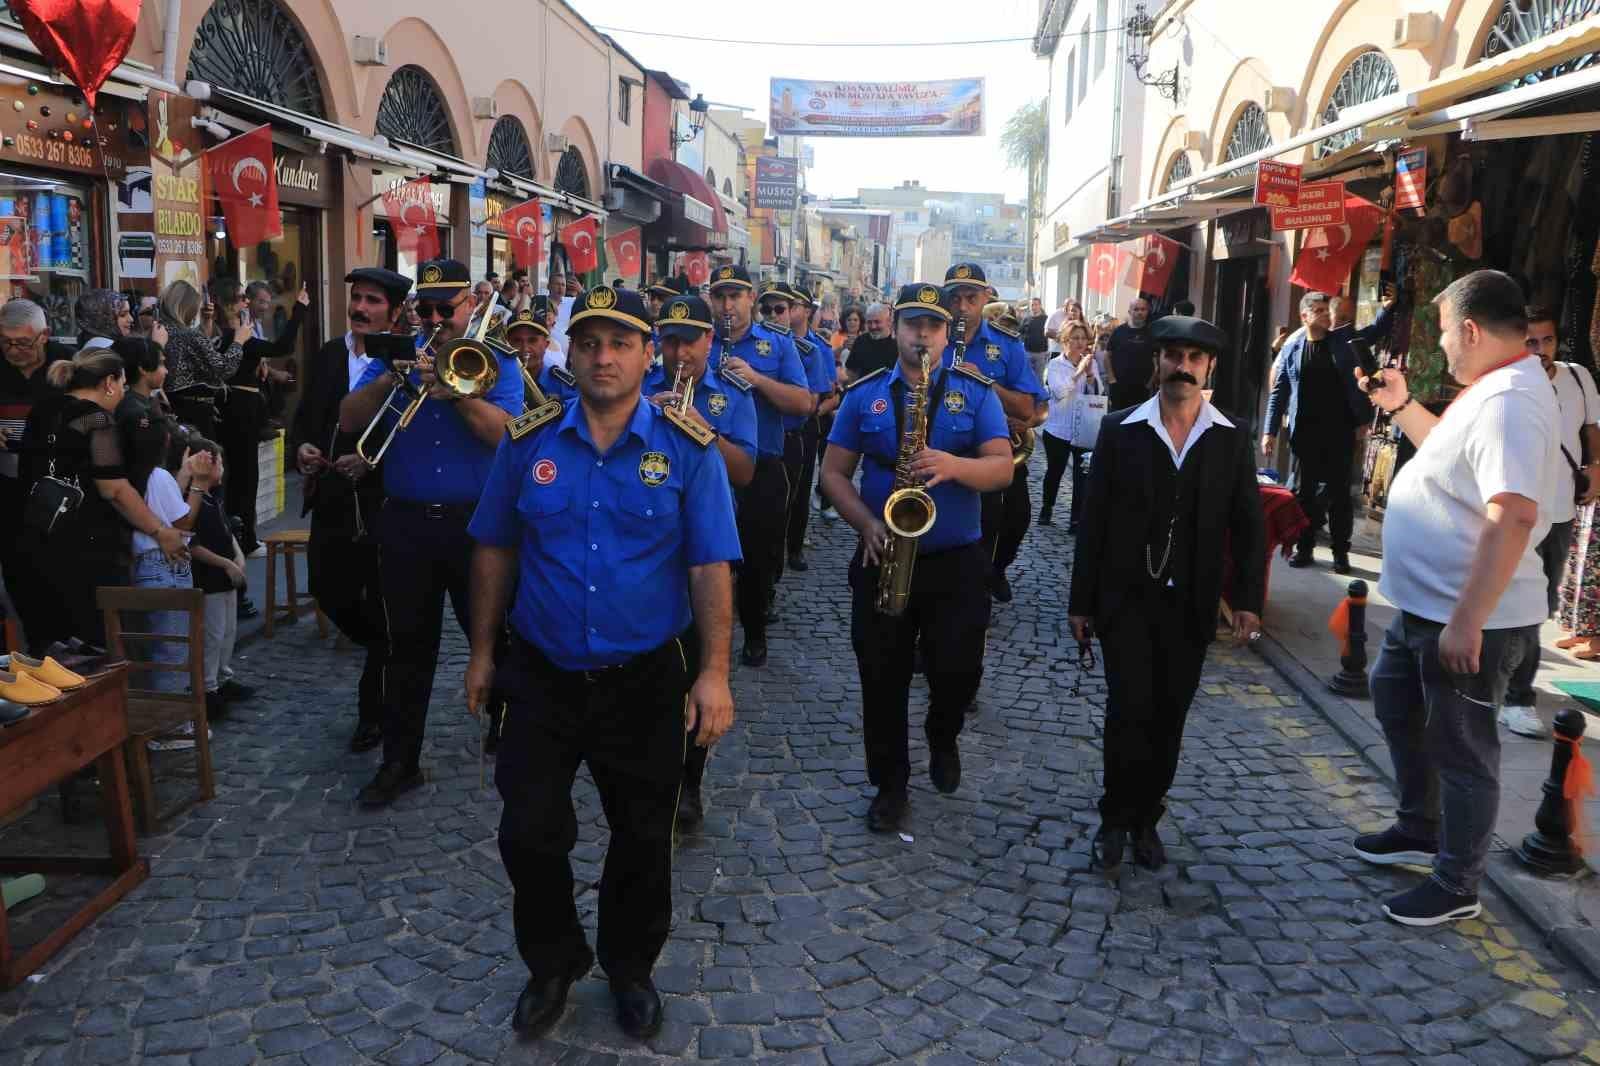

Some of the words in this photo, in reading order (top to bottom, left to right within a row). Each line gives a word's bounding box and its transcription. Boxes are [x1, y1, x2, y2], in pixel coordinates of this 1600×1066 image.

[835, 83, 872, 93] ADANA
[16, 133, 44, 159] 0533
[46, 140, 65, 163] 267
[68, 144, 92, 168] 8306
[273, 154, 319, 192] Kundura
[156, 175, 199, 203] STAR
[757, 186, 795, 197] MUSKO
[158, 208, 201, 236] BİLARDO
